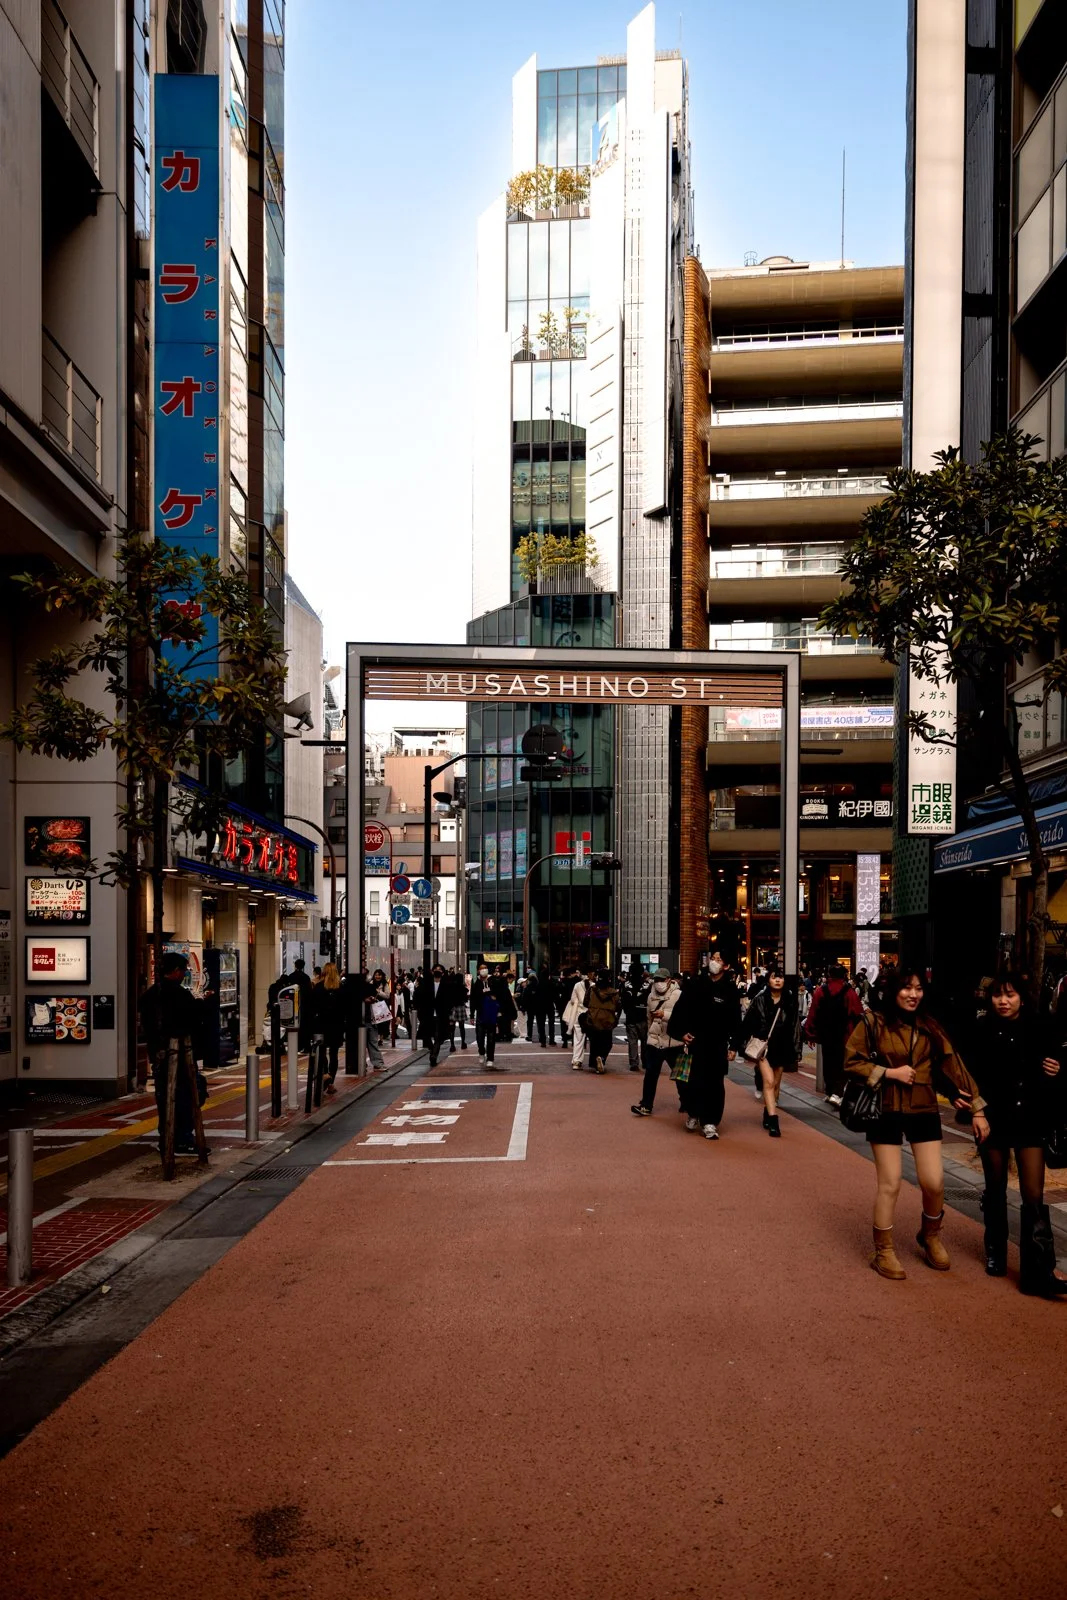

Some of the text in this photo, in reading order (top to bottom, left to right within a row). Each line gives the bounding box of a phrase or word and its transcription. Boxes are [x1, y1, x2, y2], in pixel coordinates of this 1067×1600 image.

[426, 673, 724, 700] MUSASHINO ST.
[919, 691, 947, 700] メガネ
[913, 747, 952, 755] サングラス
[838, 800, 894, 818] 紀伊國
[1017, 820, 1064, 851] Shseido
[939, 843, 973, 868] Shinseido
[44, 879, 84, 890] Darts UP
[395, 910, 403, 922] P
[858, 952, 877, 962] 15:38
